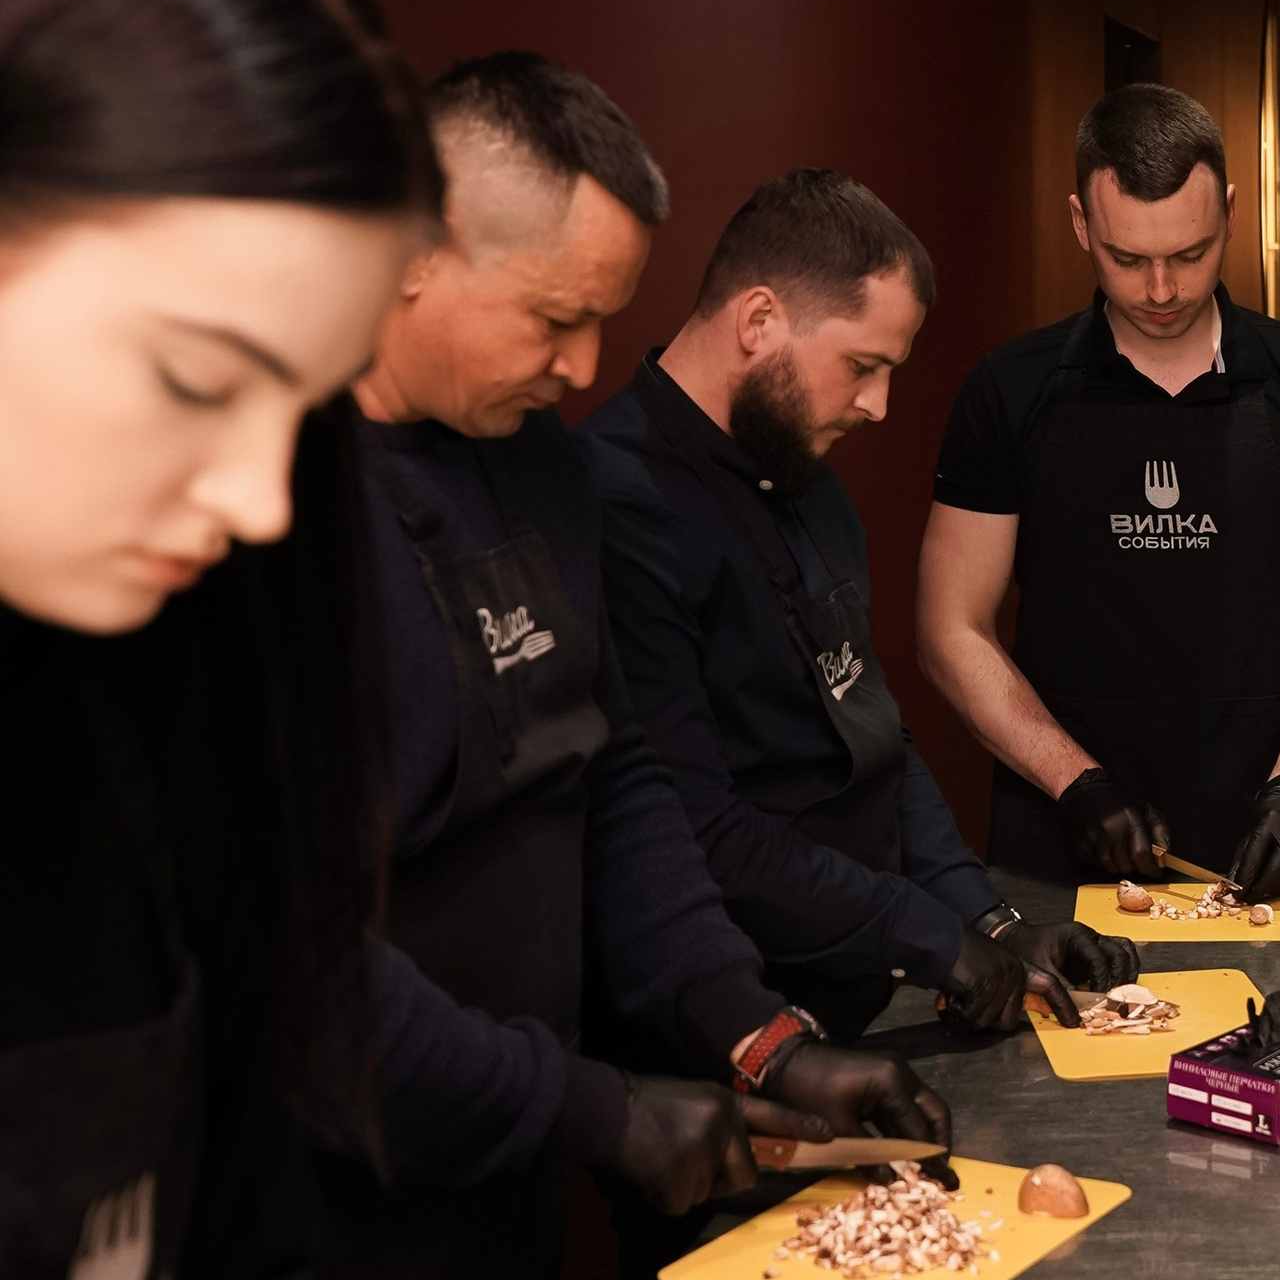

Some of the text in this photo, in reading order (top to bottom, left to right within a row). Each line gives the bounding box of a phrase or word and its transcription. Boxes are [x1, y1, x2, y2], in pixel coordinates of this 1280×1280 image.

[1109, 513, 1219, 534] ВИЛКА
[1118, 536, 1210, 550] СОБЫТИЯ
[1173, 1060, 1276, 1094] ВИНИЛОВЫЕ ПЕРЧАТКИ
